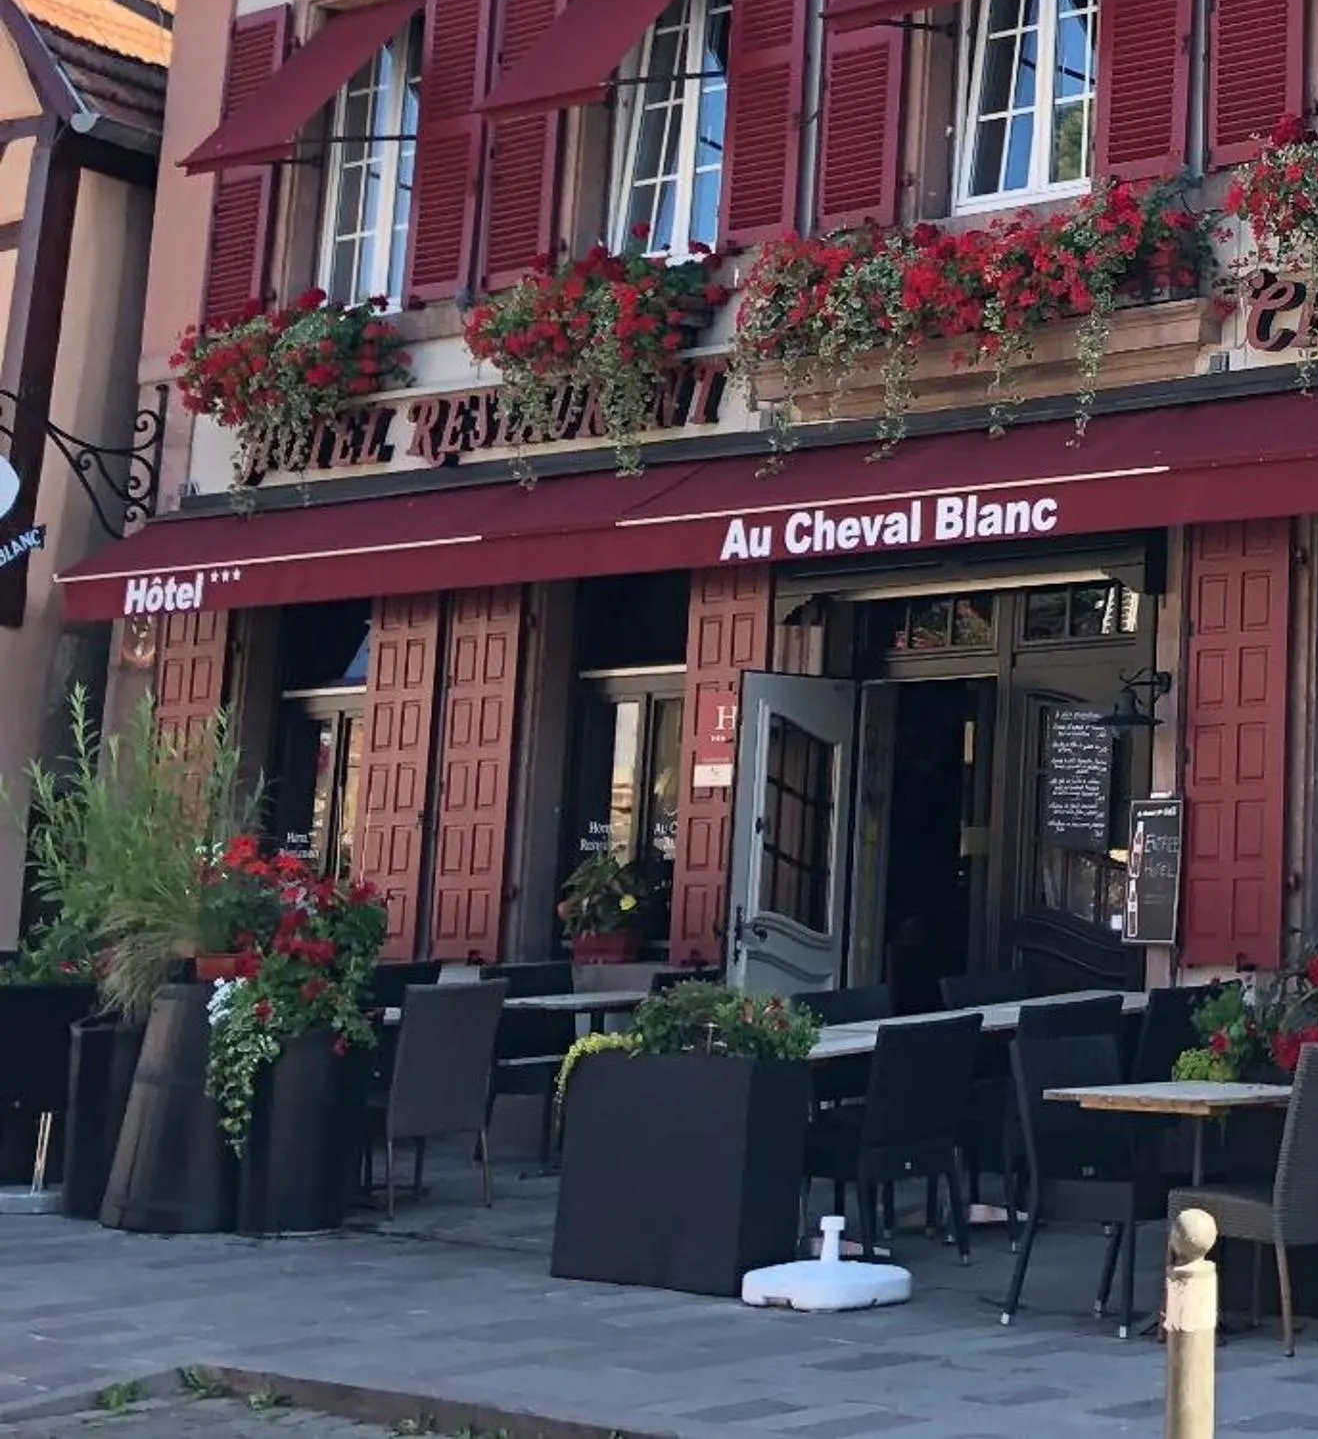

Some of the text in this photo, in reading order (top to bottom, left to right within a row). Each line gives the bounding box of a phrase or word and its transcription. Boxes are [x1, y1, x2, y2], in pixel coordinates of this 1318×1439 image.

[407, 361, 729, 467] RESURNT
[719, 495, 1057, 561] Au Cheval Blanc
[124, 572, 204, 615] Hôtel
